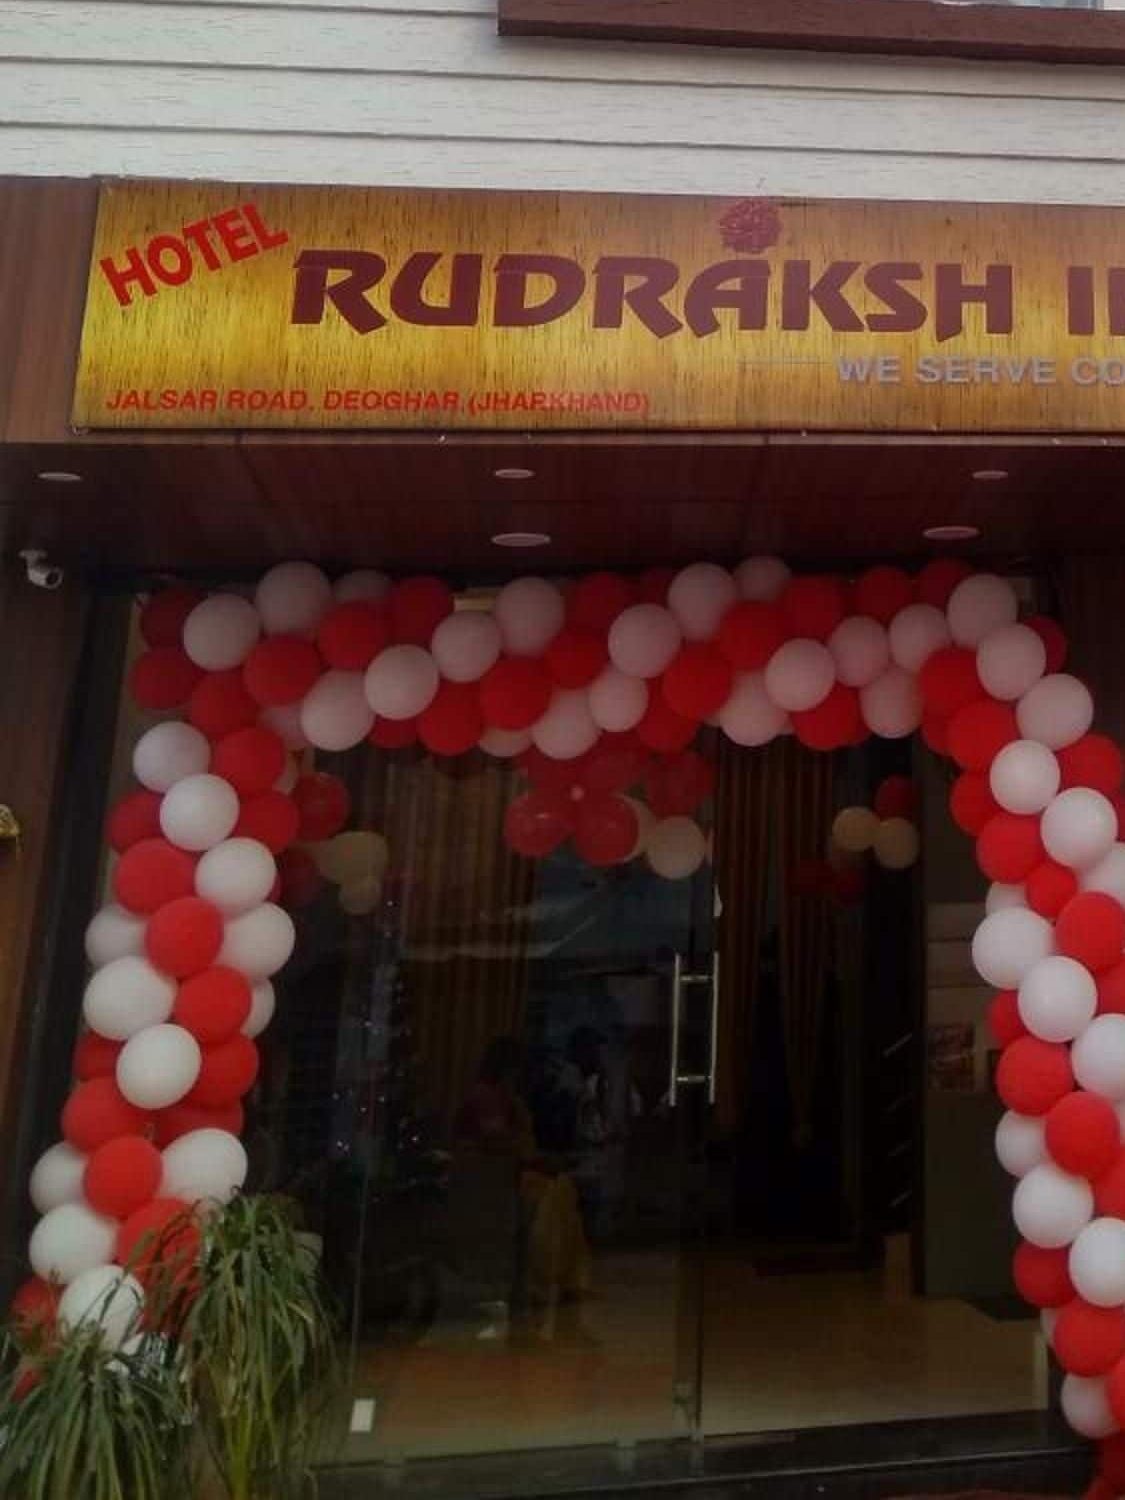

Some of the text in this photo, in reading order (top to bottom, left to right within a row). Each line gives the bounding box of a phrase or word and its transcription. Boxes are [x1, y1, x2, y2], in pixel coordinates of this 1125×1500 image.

[101, 204, 288, 305] HOTEL
[291, 249, 1013, 342] RUDRAKSH
[836, 355, 900, 384] WE
[915, 355, 1058, 386] SERVE
[106, 389, 218, 412] JALSAR
[323, 389, 460, 412] DEOGHAR
[467, 390, 649, 417] (JHARKHAND)
